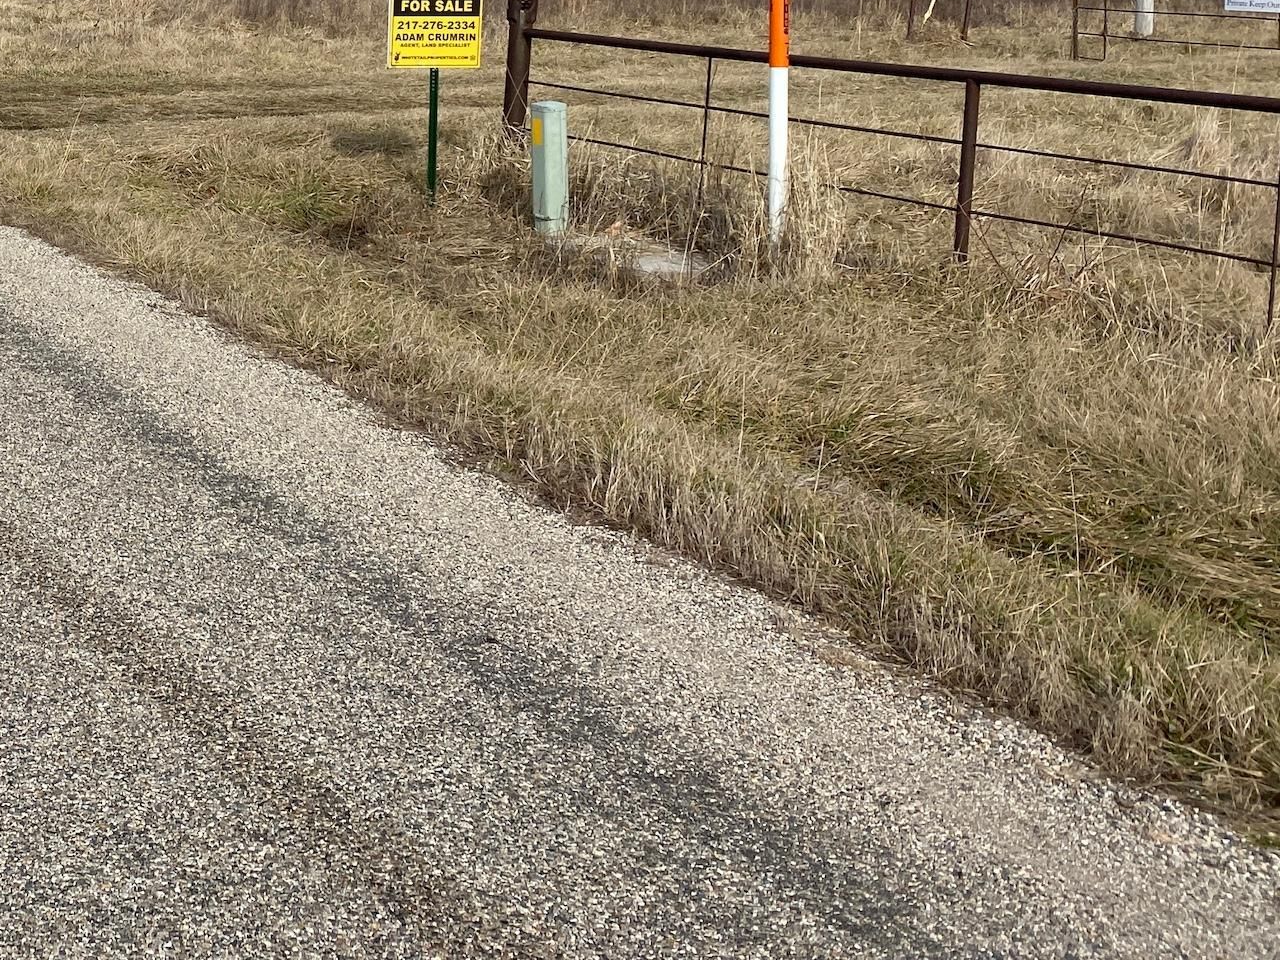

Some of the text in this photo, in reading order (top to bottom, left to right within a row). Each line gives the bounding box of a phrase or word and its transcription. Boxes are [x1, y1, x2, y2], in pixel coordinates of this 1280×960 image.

[400, 0, 473, 12] FOR SALE
[397, 21, 476, 30] 217-276-2334
[395, 33, 476, 41] ADAM CRUMRIN
